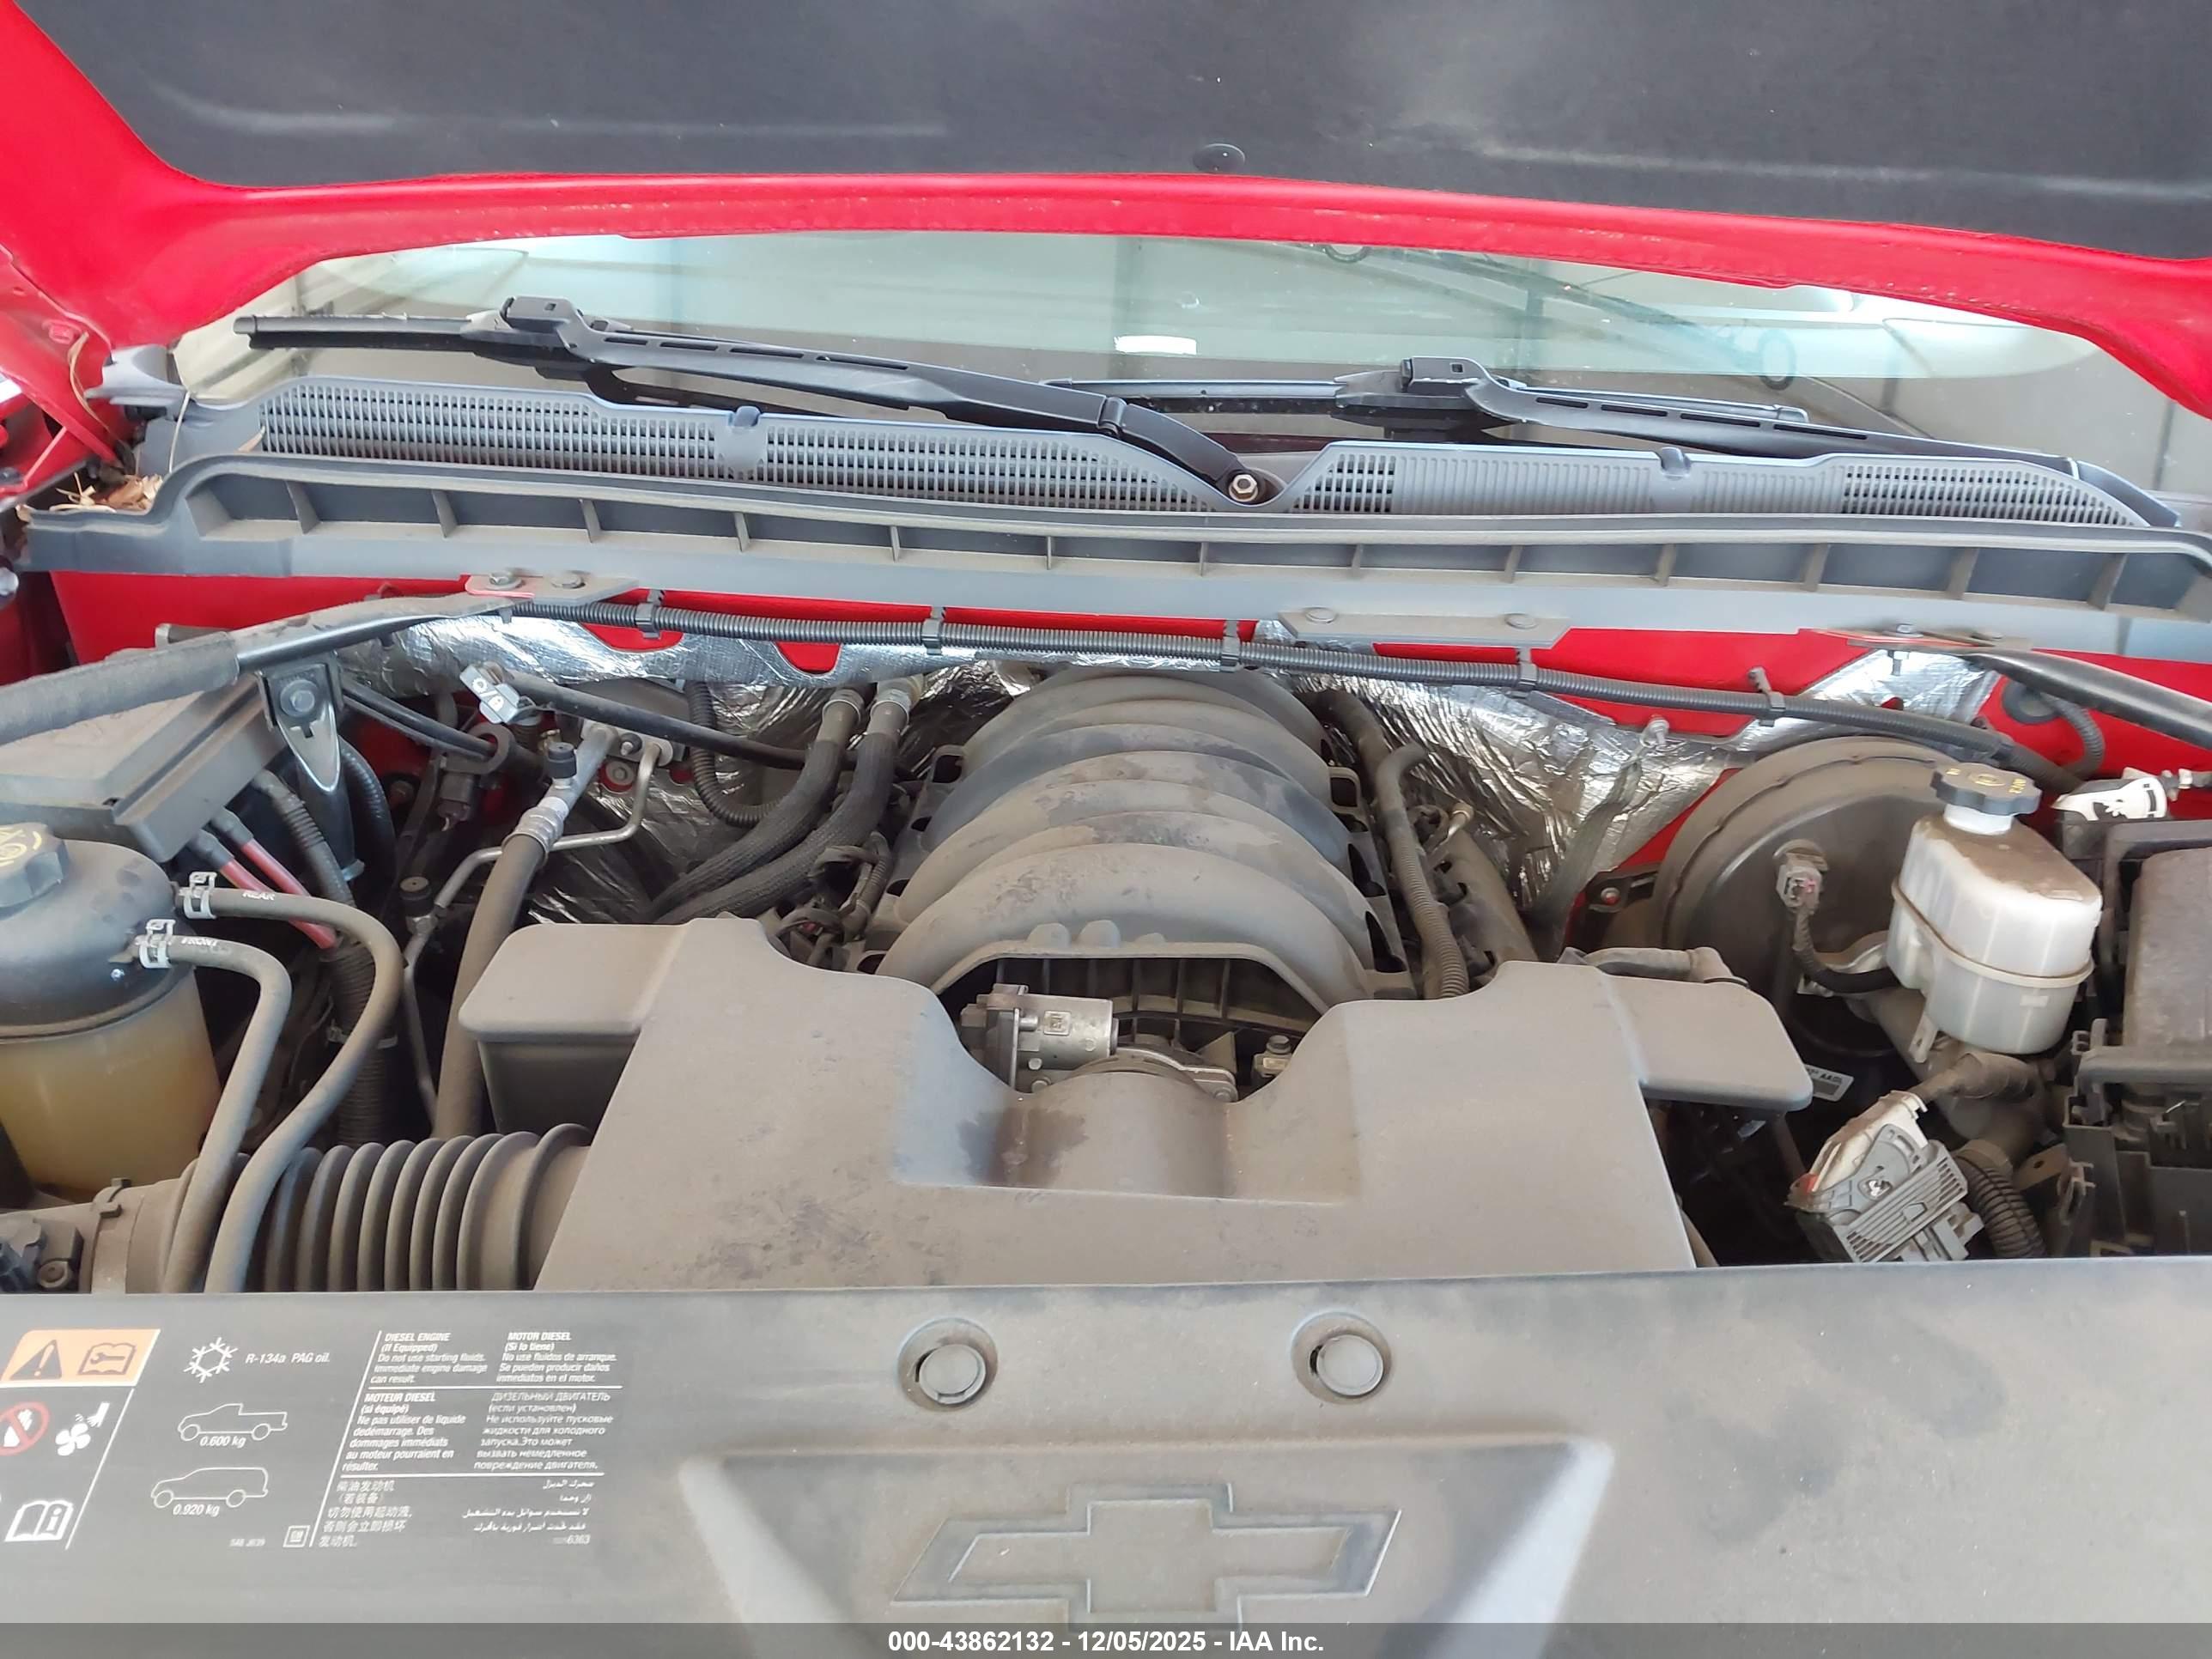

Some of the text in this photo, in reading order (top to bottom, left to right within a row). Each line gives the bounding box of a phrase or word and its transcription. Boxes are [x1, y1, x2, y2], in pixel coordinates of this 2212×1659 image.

[385, 1333, 452, 1341] DIESEL ENGINE
[507, 1332, 572, 1340] MOTOR DIESEL
[393, 1343, 438, 1353] Equipped)
[245, 1353, 287, 1364] R-134a
[291, 1352, 314, 1363] PAG
[378, 1353, 390, 1362] Do
[392, 1353, 406, 1362] not
[424, 1353, 459, 1364] starting
[421, 1364, 451, 1374] engine
[452, 1364, 488, 1373] damage
[499, 1363, 511, 1371] Se
[512, 1364, 545, 1373] pueden
[546, 1364, 582, 1373] producir
[364, 1392, 435, 1402] MOTEUR DIESEL
[555, 1392, 611, 1401] ДВИГАТЕЛЬ
[362, 1404, 374, 1414] (si
[489, 1403, 577, 1414] (если установлен)
[357, 1415, 466, 1425] Ne pas utiliser de liquide
[486, 1415, 500, 1424] Не
[565, 1415, 613, 1425] пусковые
[416, 1425, 434, 1435] Des
[199, 1435, 246, 1449] 0.600 kg
[349, 1437, 448, 1449] dommages immédiats
[346, 1450, 358, 1460] au
[359, 1449, 392, 1459] moteur
[393, 1449, 441, 1461] pourraient
[473, 1462, 599, 1471] повреждение двигателя.
[173, 1504, 221, 1517] 0.920 kg
